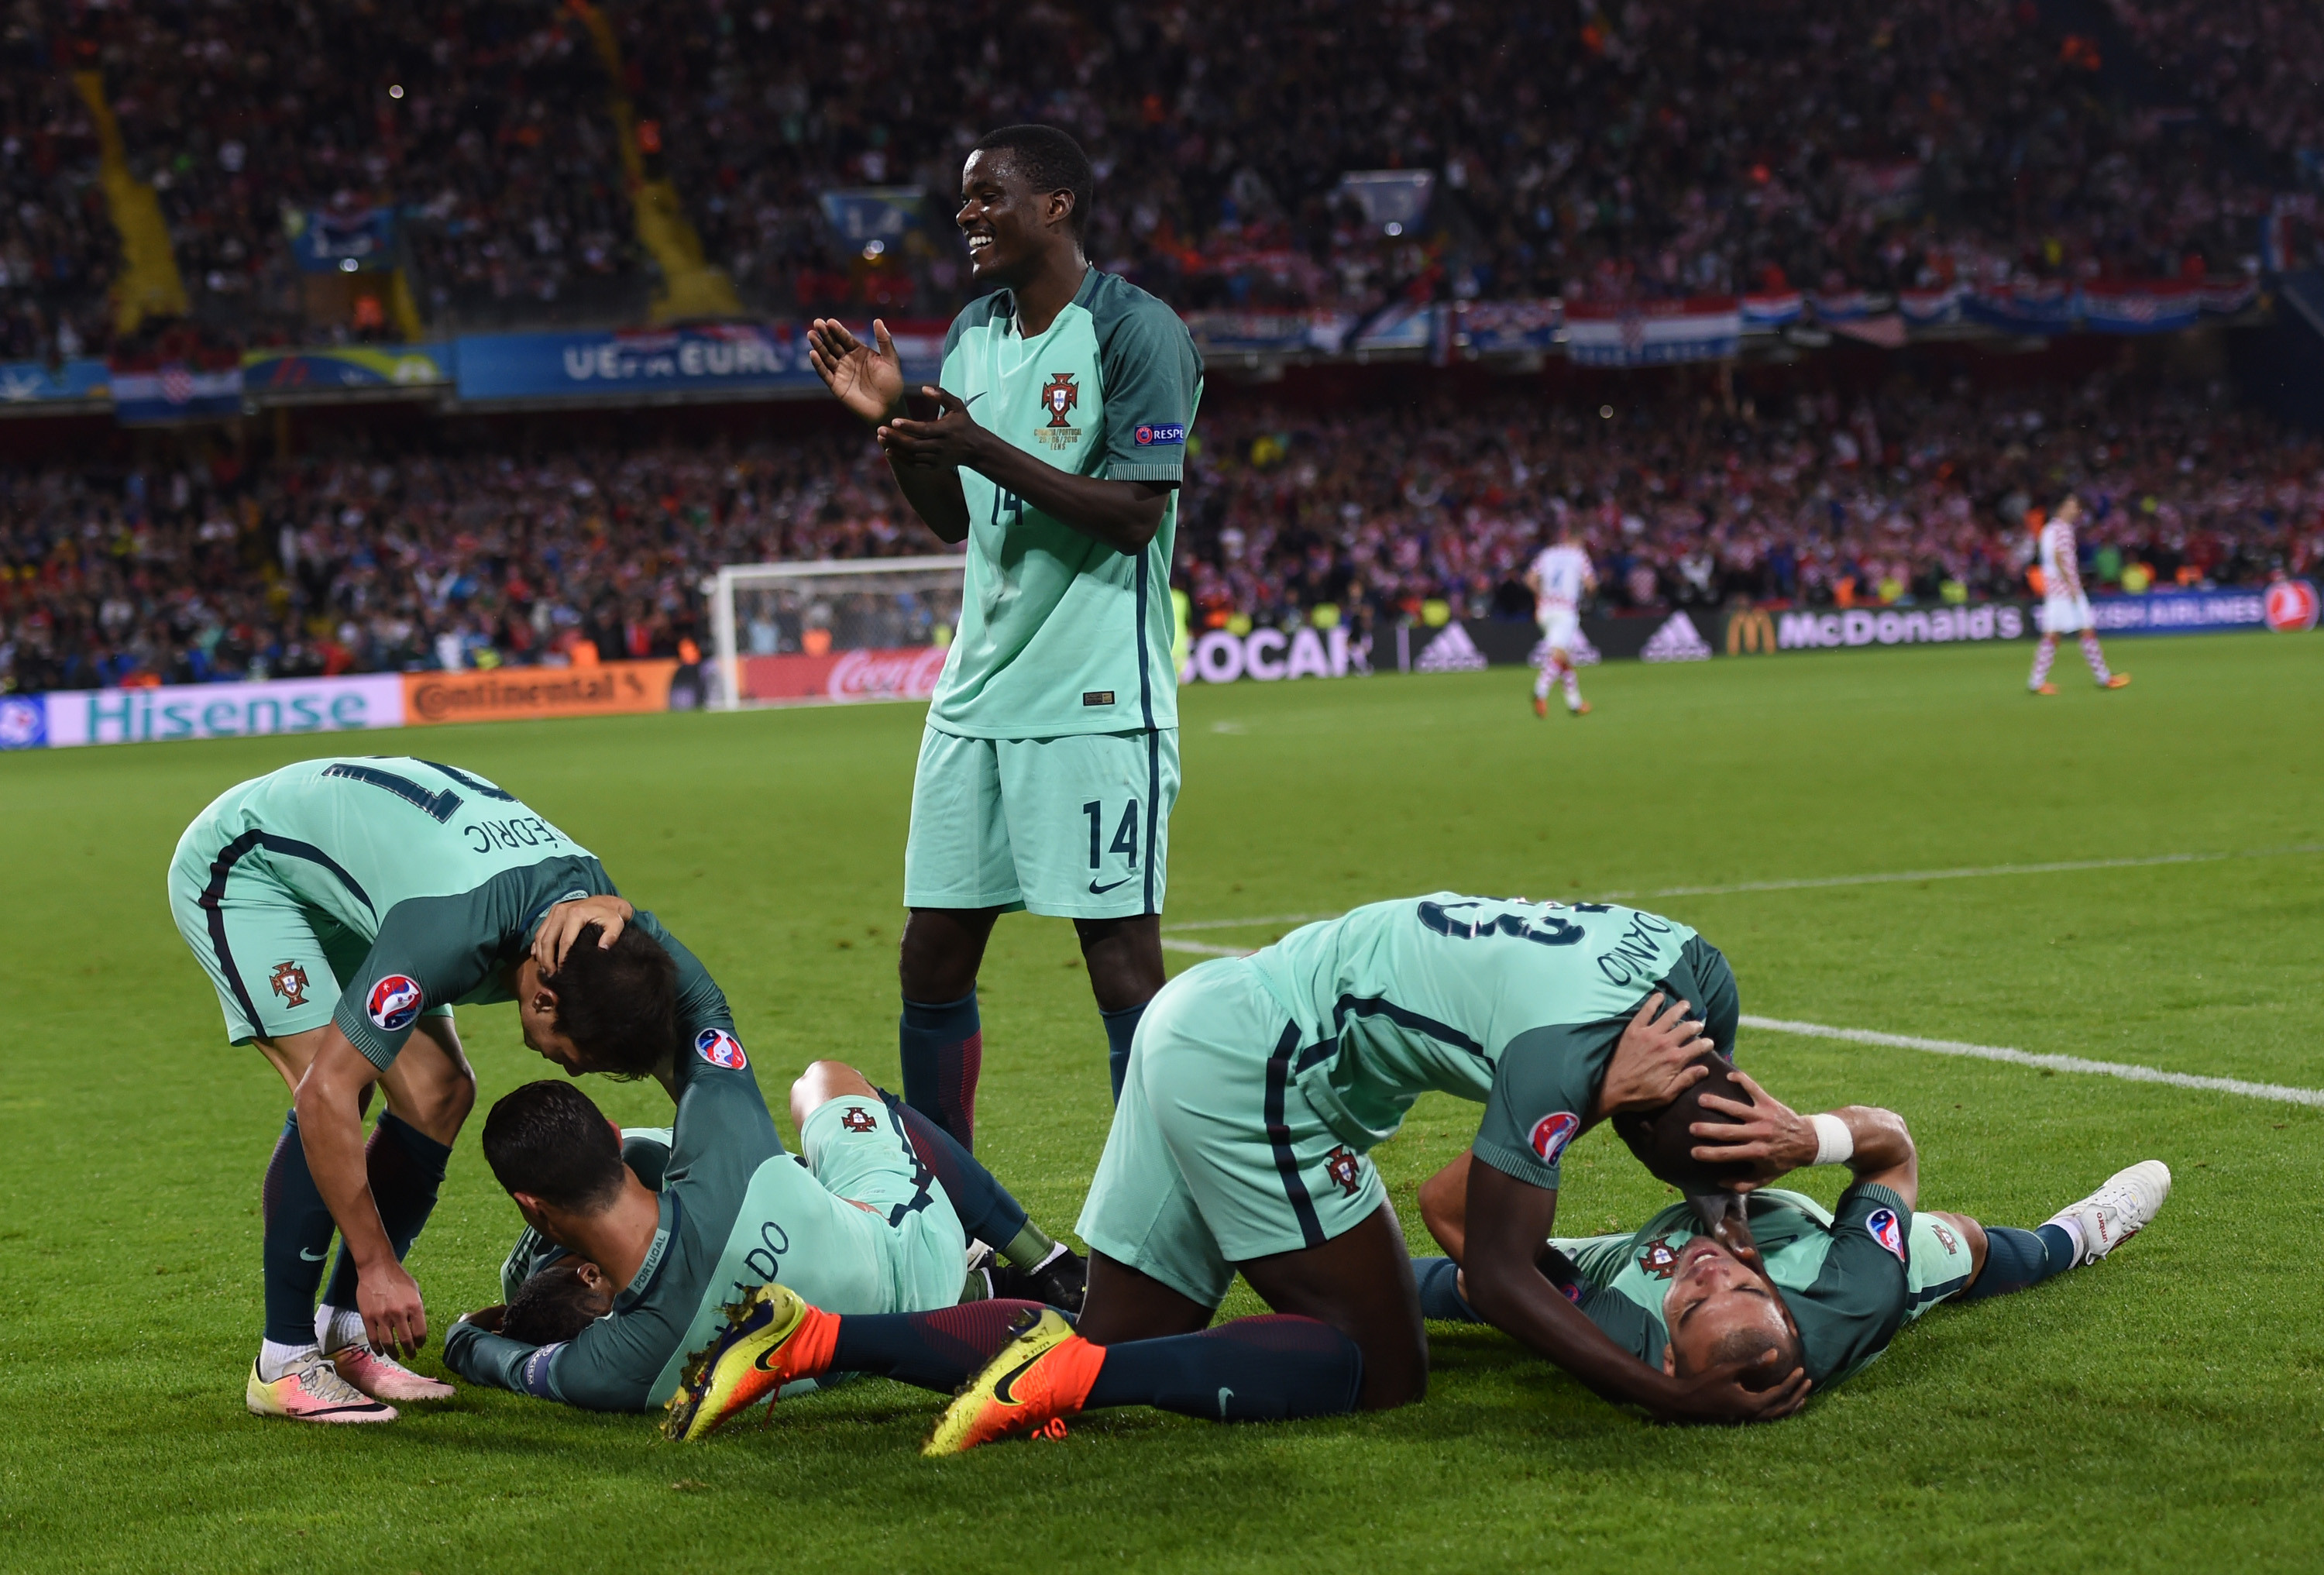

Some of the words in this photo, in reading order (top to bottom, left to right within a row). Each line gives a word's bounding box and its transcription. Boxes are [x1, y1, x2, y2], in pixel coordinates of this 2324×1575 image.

[1778, 604, 2024, 649] McDonald's
[87, 688, 369, 741] Hisense
[414, 671, 615, 721] Continental
[1083, 799, 1138, 869] 14
[2097, 1212, 2108, 1243] umbro
[634, 1236, 665, 1289] PORTUGAL
